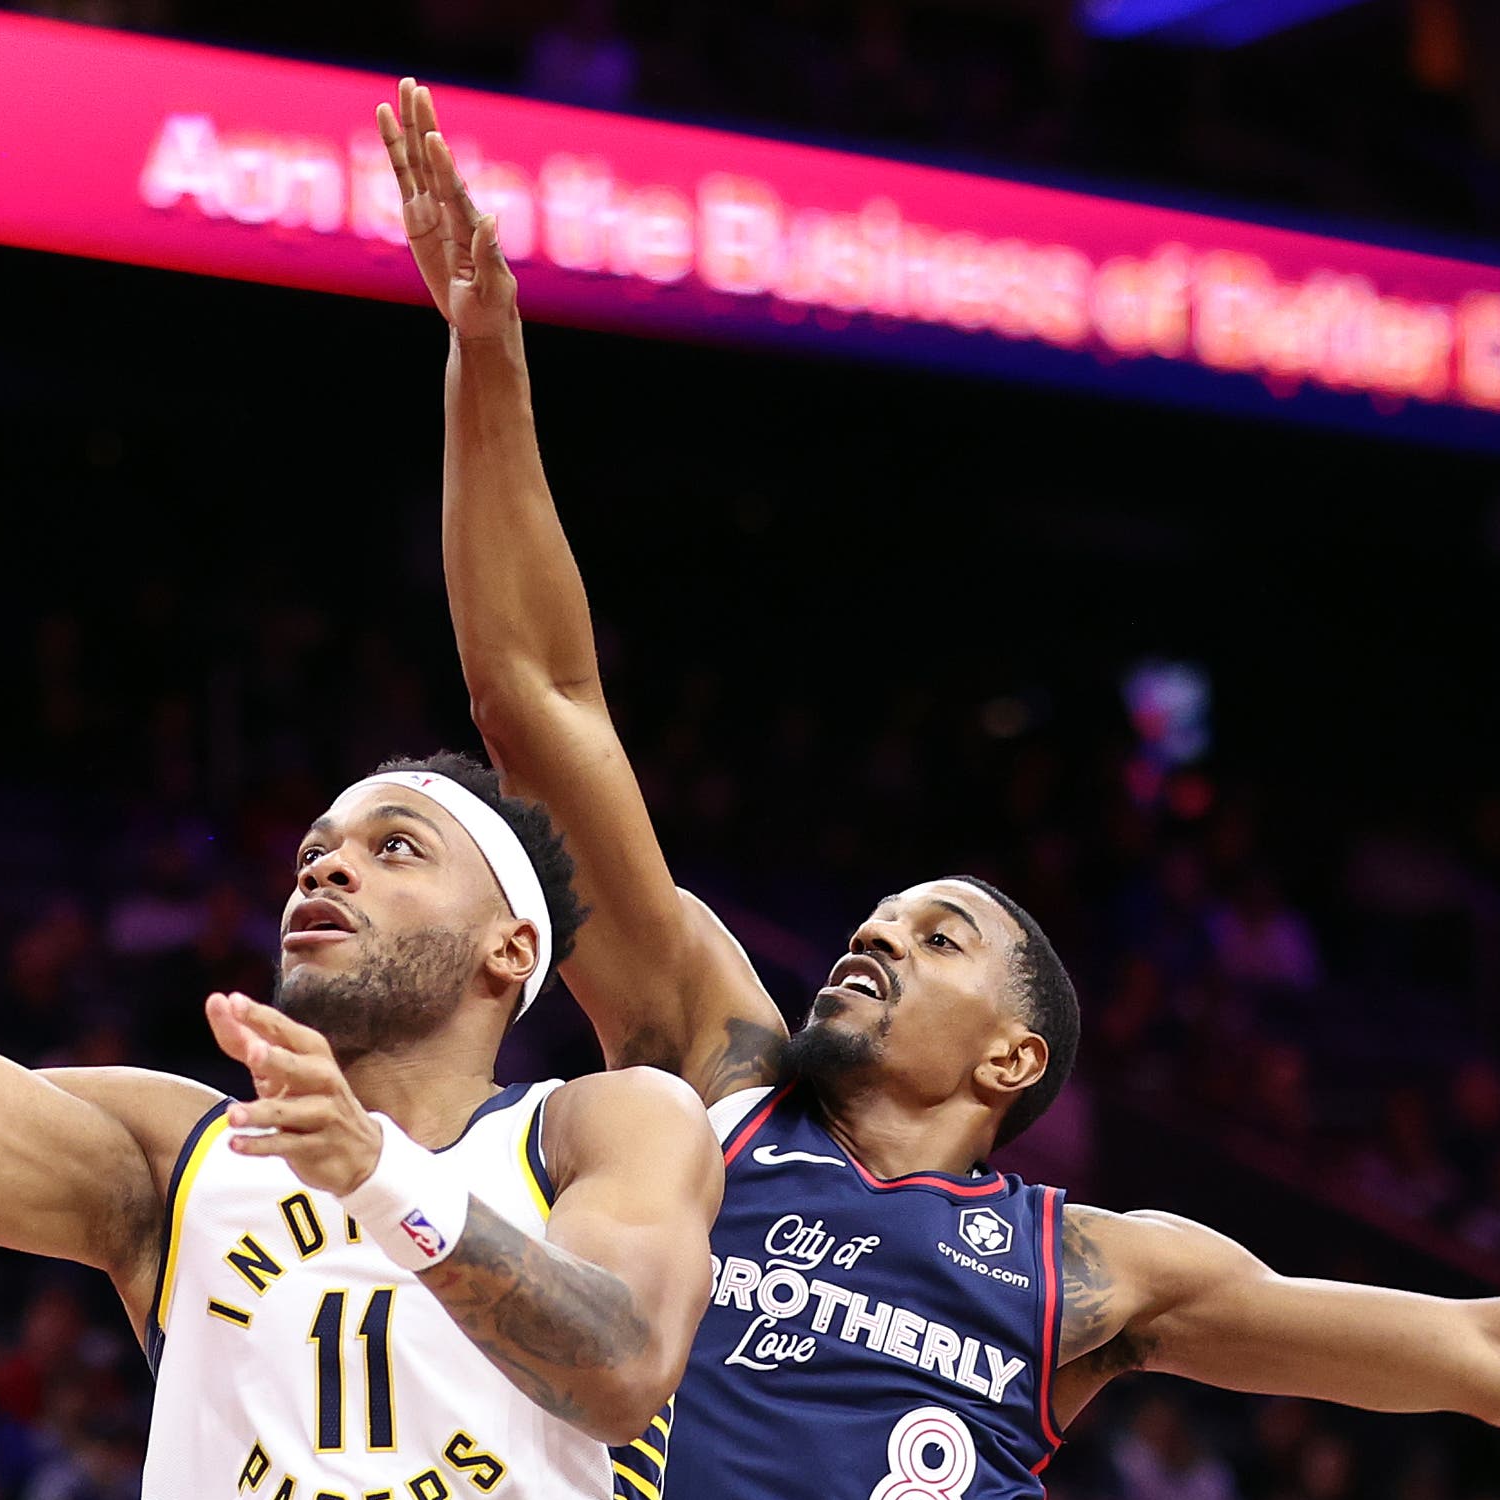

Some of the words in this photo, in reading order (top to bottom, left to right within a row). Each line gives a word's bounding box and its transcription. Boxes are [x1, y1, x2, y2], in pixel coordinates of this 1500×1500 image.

[142, 114, 343, 232] Aon
[541, 154, 694, 282] the
[698, 174, 1094, 345] Business
[1095, 242, 1190, 358] of
[208, 1190, 362, 1330] INDI
[765, 1215, 831, 1270] City
[835, 1235, 880, 1269] of
[937, 1241, 1030, 1289] crypto.com
[307, 1286, 398, 1454] 11
[725, 1316, 816, 1371] Love
